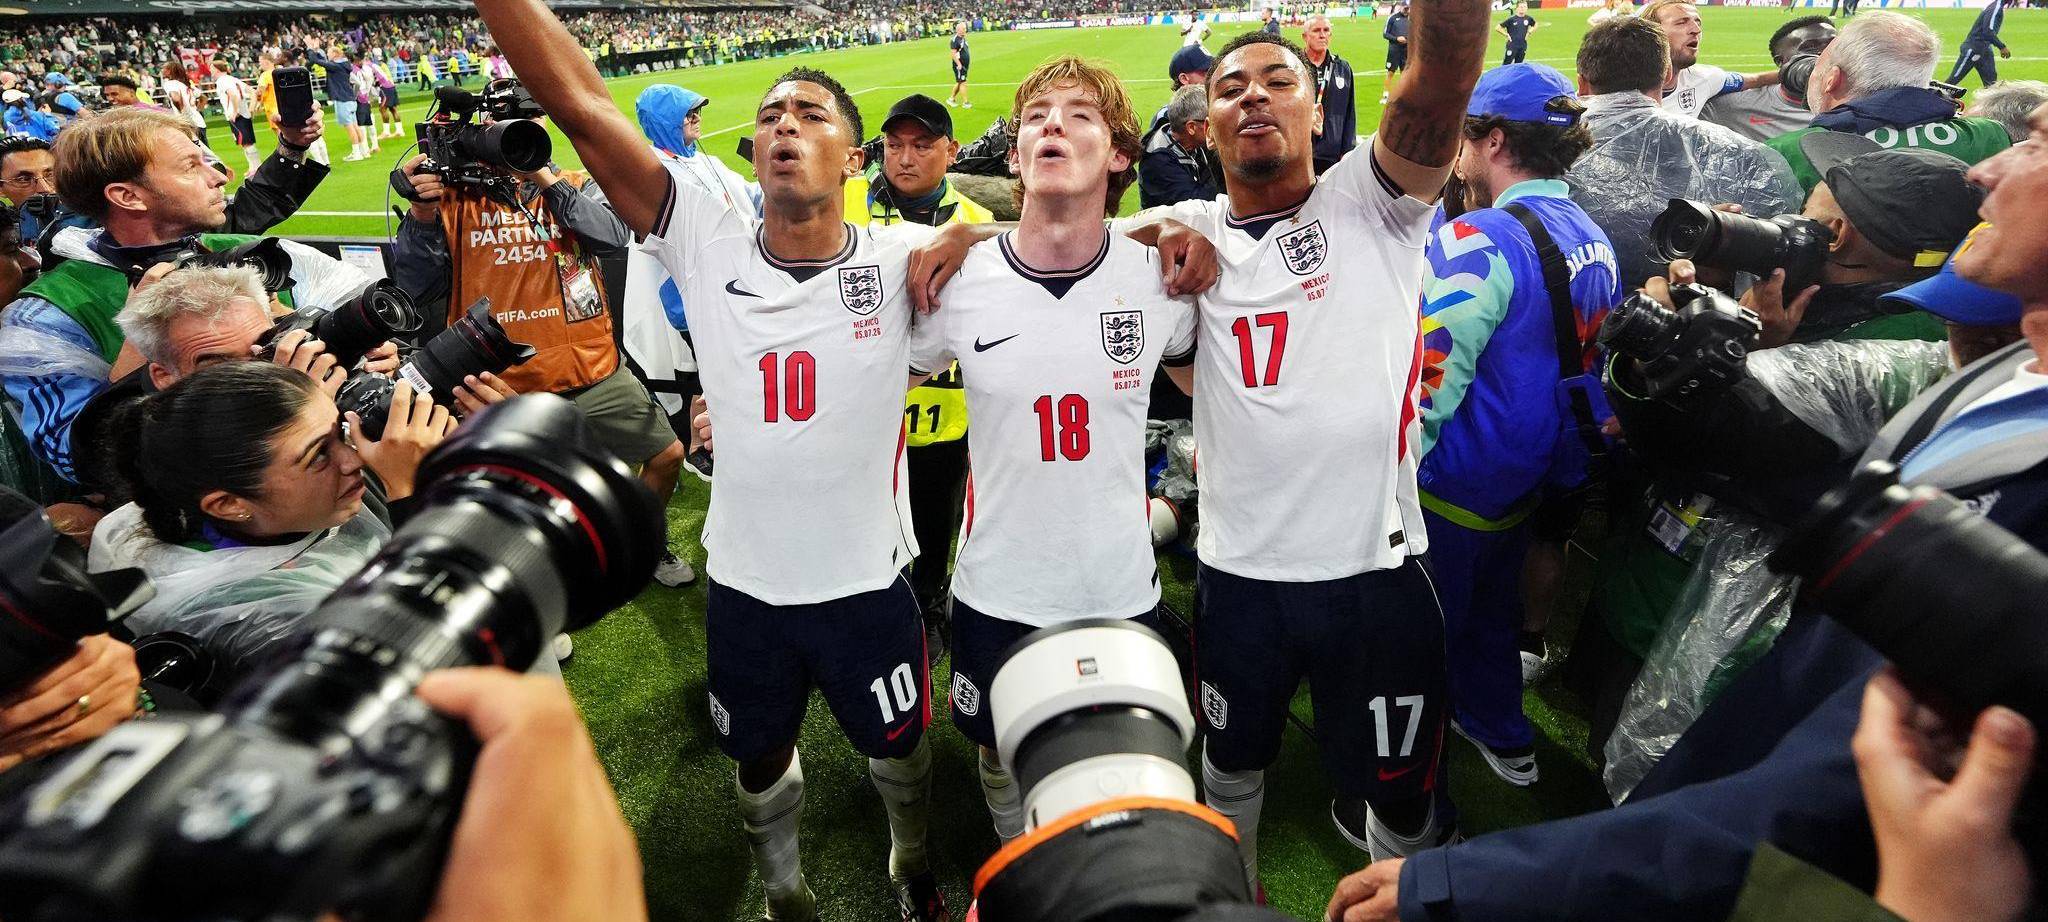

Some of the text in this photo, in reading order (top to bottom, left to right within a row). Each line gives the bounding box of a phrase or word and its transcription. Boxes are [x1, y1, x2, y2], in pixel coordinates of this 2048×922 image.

[1079, 17, 1107, 27] QATAR
[1109, 16, 1145, 26] AIRWAYS
[1865, 122, 1958, 149] OTO
[470, 223, 562, 247] PARTNR
[494, 245, 548, 265] 2454
[496, 307, 560, 323] FIFA.com
[854, 317, 879, 328] MEXICO
[854, 327, 882, 339] 05.07.26
[1231, 311, 1289, 388] 17
[1113, 368, 1140, 379] MEXICO
[759, 351, 816, 423] 10
[1114, 379, 1140, 391] 05.07.26
[1034, 394, 1091, 462] 18
[870, 662, 918, 724] 10
[1368, 694, 1424, 757] 17
